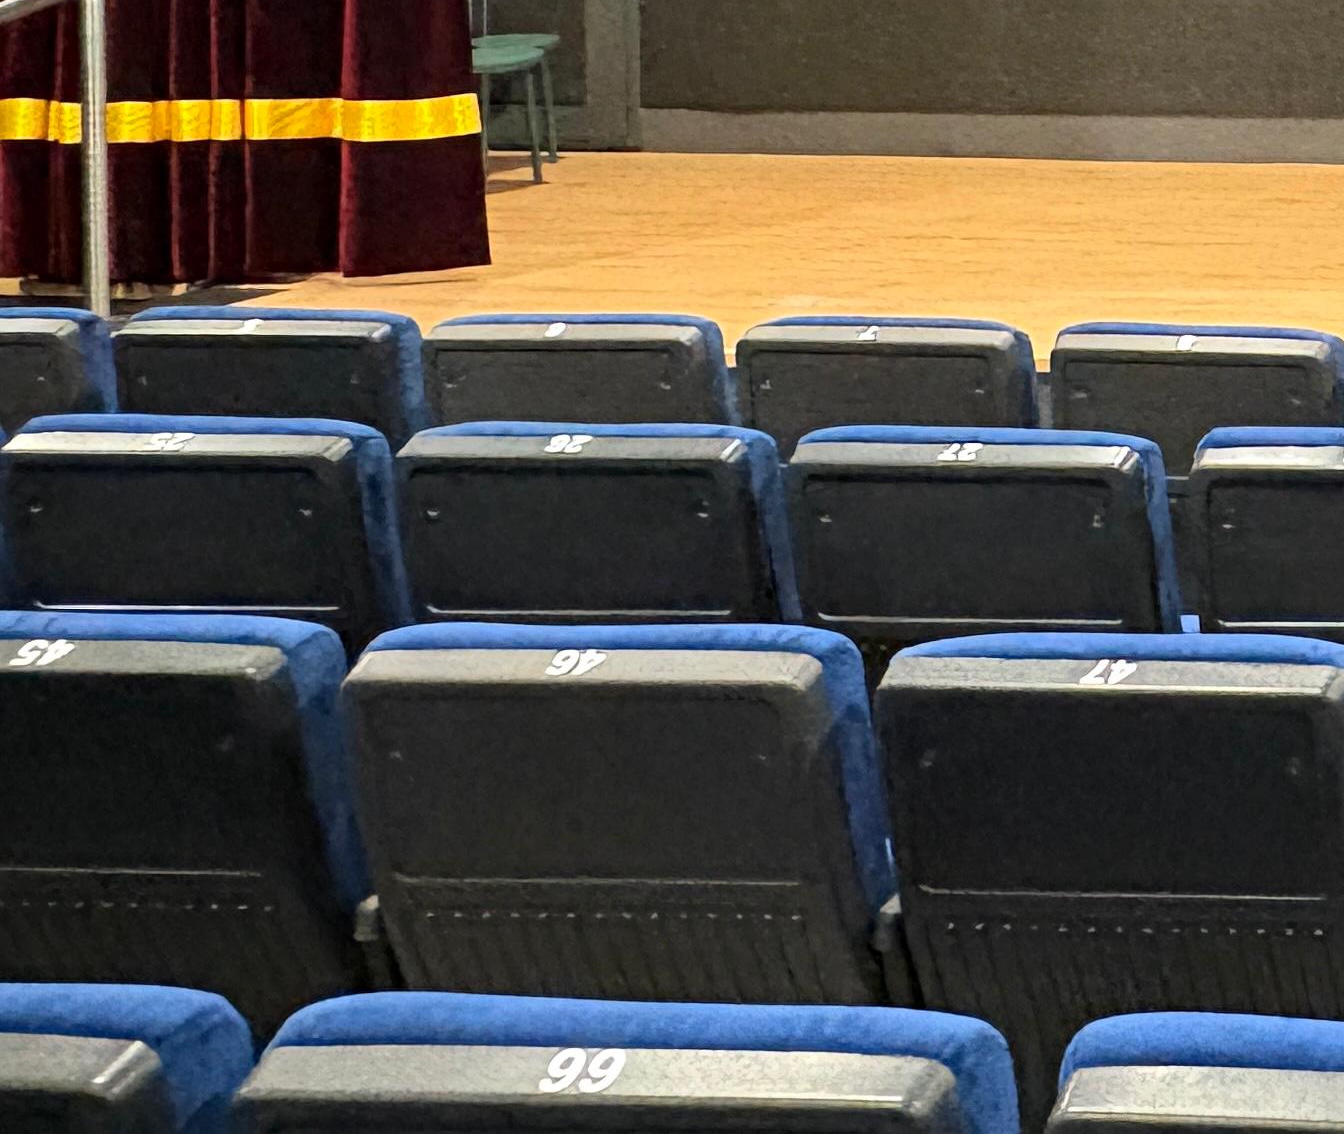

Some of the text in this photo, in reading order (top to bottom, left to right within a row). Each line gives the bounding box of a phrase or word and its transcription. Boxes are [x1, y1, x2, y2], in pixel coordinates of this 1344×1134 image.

[937, 442, 984, 461] 27
[9, 639, 75, 666] 45
[545, 649, 607, 676] 46
[1079, 659, 1138, 689] 47
[539, 1048, 627, 1094] 66
